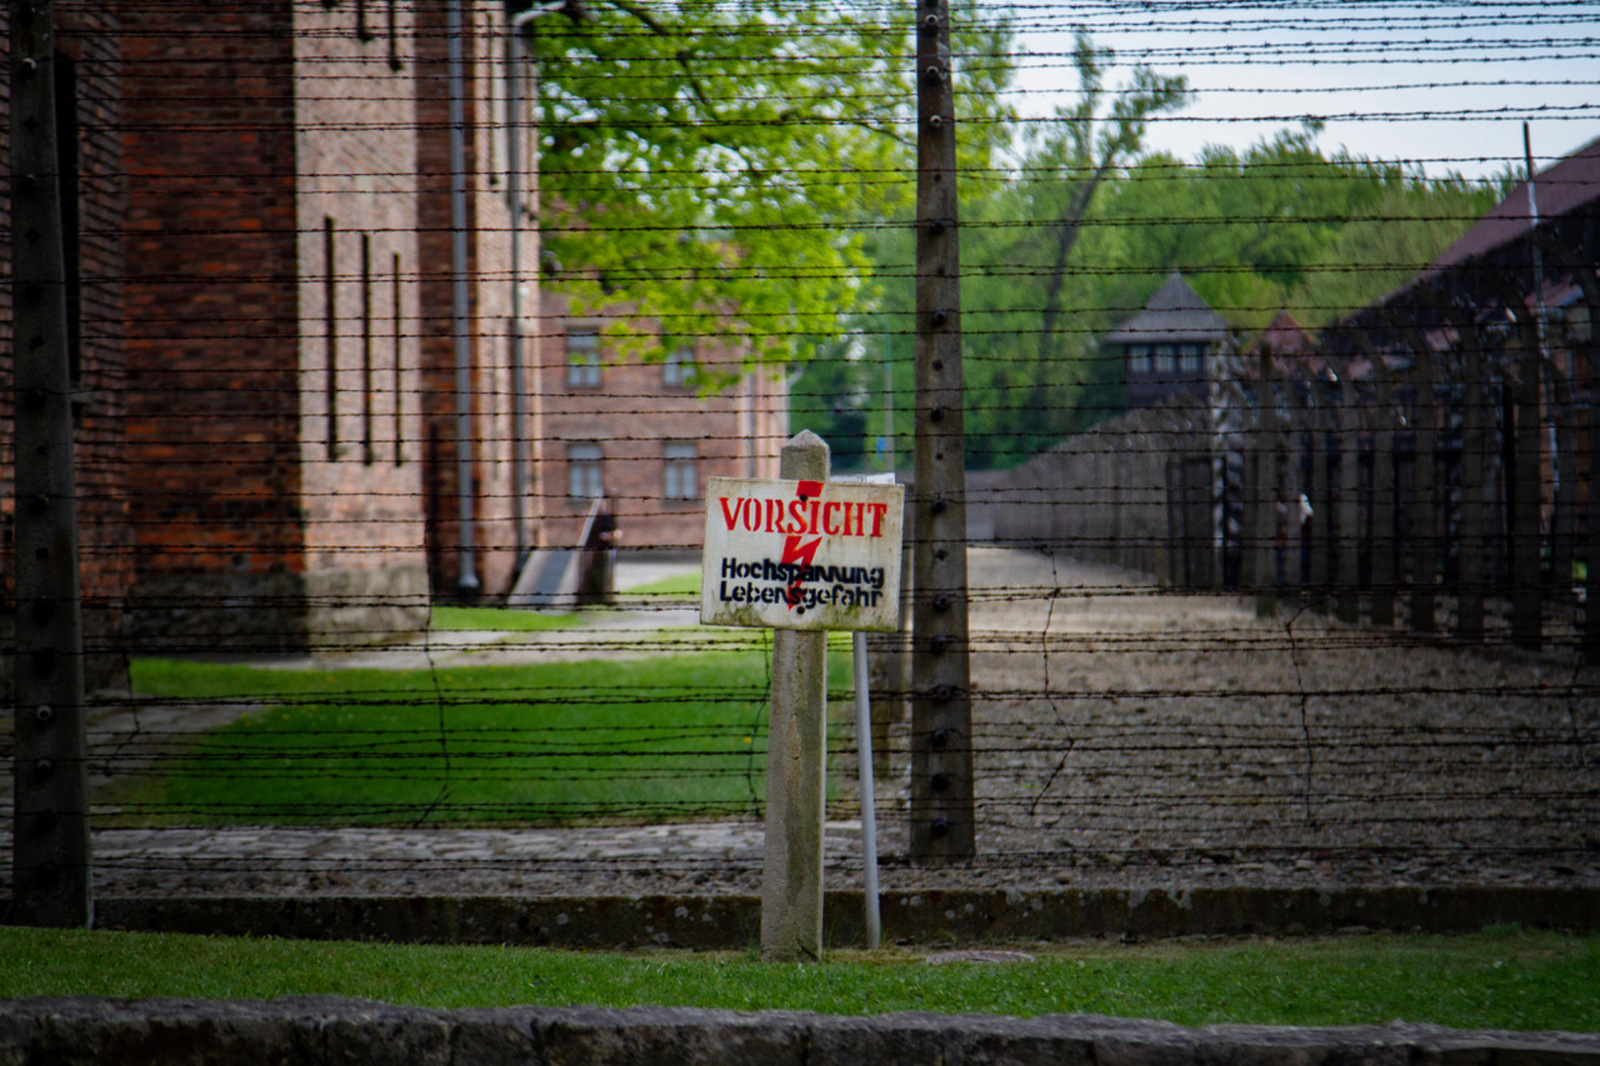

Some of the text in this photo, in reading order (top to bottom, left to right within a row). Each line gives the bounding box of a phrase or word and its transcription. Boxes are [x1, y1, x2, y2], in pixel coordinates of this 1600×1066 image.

[719, 497, 887, 538] VORSICHT
[721, 557, 885, 589] Hochspannung
[719, 581, 883, 609] Lebensgefahr
